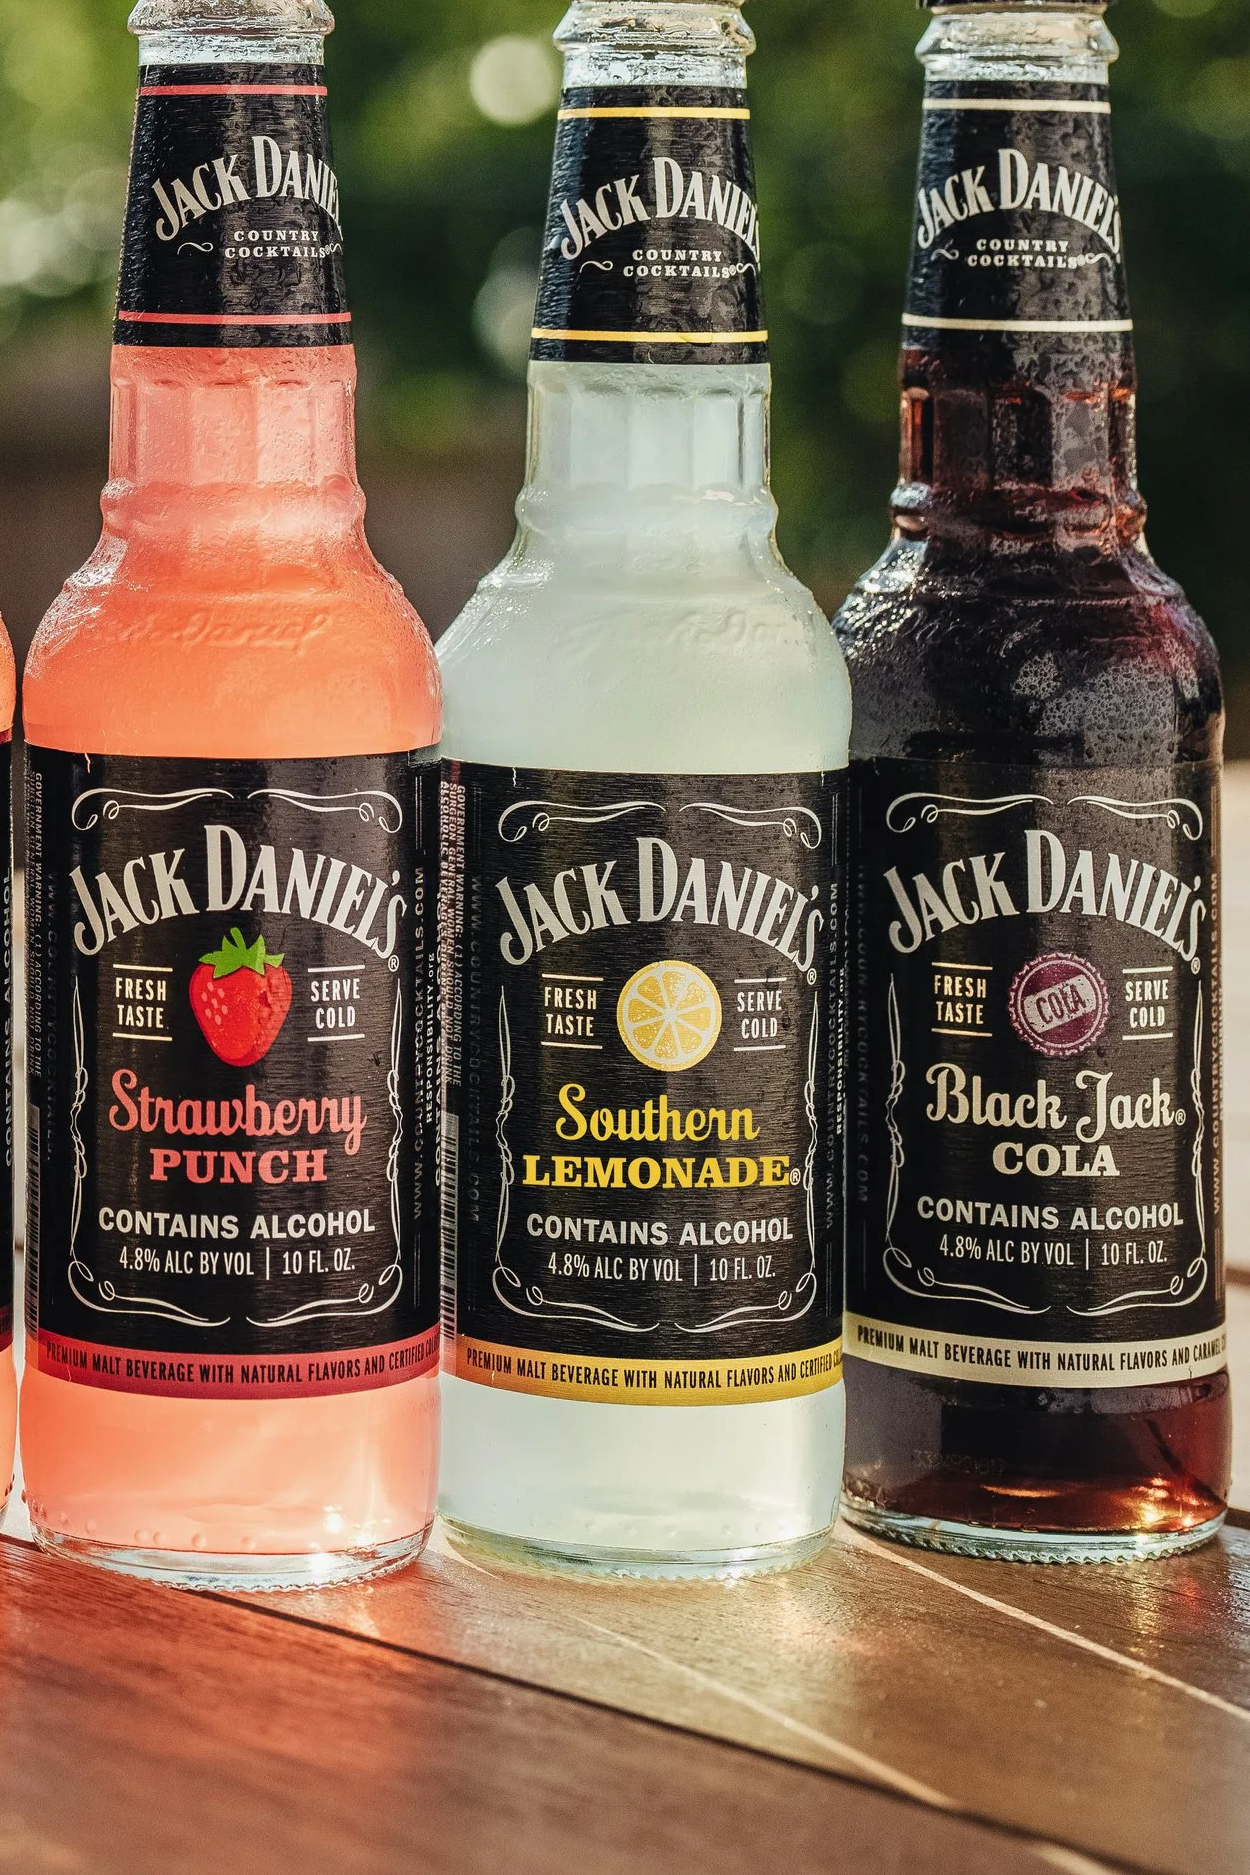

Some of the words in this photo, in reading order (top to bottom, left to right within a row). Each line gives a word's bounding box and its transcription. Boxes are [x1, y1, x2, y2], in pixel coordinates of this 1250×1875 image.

[151, 154, 251, 241] JACK
[917, 165, 994, 249] JACK
[560, 174, 651, 260] JACK
[234, 230, 319, 241] COUNTRY
[976, 239, 1069, 252] COUNTRY
[632, 249, 722, 261] COUNTRY
[69, 847, 199, 956] JACK
[495, 860, 631, 965] JACK
[883, 852, 1020, 954] JACK
[115, 978, 167, 1002] FRESH
[310, 978, 360, 1002] SERVE
[544, 986, 598, 1010] FRESH
[736, 989, 782, 1013] SERVE
[934, 974, 988, 999] FRESH
[1125, 979, 1169, 1002] SERVE
[117, 1004, 164, 1029] TASTE
[315, 1005, 356, 1028] COLD
[936, 1001, 984, 1025] TASTE
[1035, 984, 1085, 1024] COLA
[1129, 1005, 1165, 1028] COLD
[545, 1014, 594, 1038] TASTE
[741, 1017, 778, 1040] COLD
[108, 1068, 367, 1155] Strawberry
[926, 1063, 1067, 1130] Black
[555, 1083, 761, 1142] Southern
[149, 1148, 328, 1184] PUNCH
[992, 1142, 1120, 1177] COLA
[98, 1207, 239, 1240] CONTAINS
[250, 1209, 375, 1238] ALCOHOL
[917, 1196, 1059, 1230] CONTAINS
[1070, 1201, 1184, 1231] ALCOHOL
[526, 1213, 668, 1246] CONTAINS
[679, 1217, 793, 1246] ALCOHOL
[119, 1246, 159, 1272] 4.8%
[165, 1251, 194, 1274] ALC
[199, 1251, 219, 1275] BY
[224, 1251, 254, 1276] VOL
[282, 1251, 302, 1275] 10
[309, 1250, 329, 1274] FL.
[333, 1247, 356, 1271] OZ.
[939, 1234, 982, 1261] 4.8%
[986, 1240, 1015, 1263] ALC
[1021, 1241, 1039, 1265] BY
[1044, 1241, 1074, 1266] VOL
[1101, 1241, 1119, 1266] 10
[1125, 1240, 1144, 1265] FL.
[1148, 1237, 1168, 1263] OZ.
[548, 1252, 590, 1279] 4.8%
[594, 1256, 623, 1280] ALC
[629, 1257, 648, 1281] BY
[652, 1258, 683, 1282] VOL
[709, 1258, 729, 1281] 10
[734, 1257, 752, 1280] FL.
[757, 1254, 776, 1278] OZ.
[857, 1324, 905, 1353] PREMIUM
[909, 1338, 939, 1358] MALT
[944, 1341, 1011, 1368] BEVERAGE
[1017, 1349, 1051, 1370] WITH
[1058, 1351, 1115, 1371] NATURAL
[1120, 1346, 1168, 1370] FLAVORS
[1172, 1342, 1191, 1364] AND
